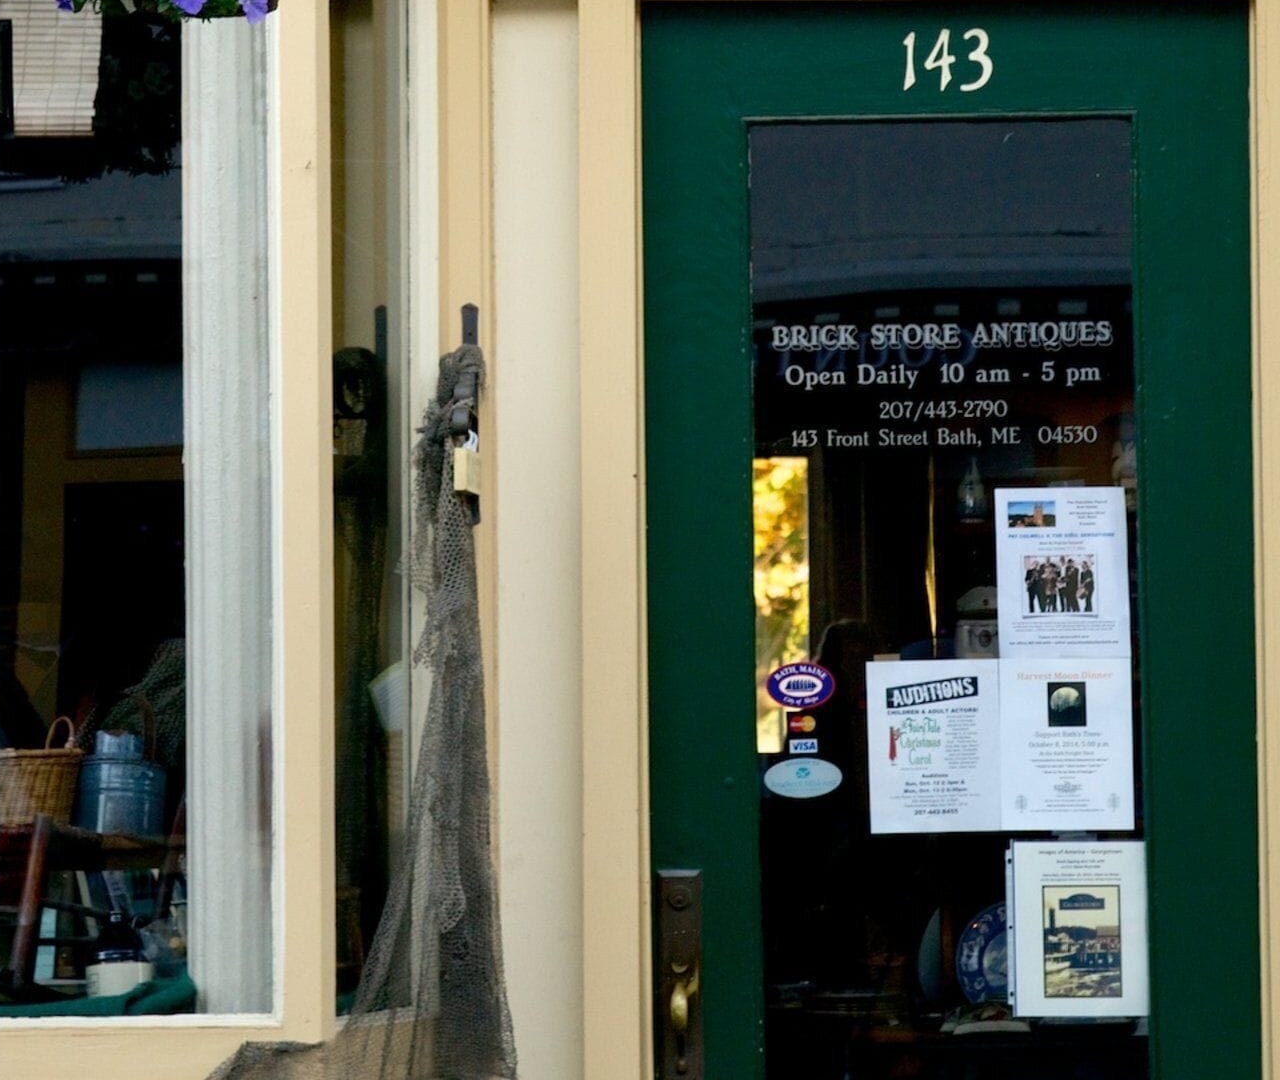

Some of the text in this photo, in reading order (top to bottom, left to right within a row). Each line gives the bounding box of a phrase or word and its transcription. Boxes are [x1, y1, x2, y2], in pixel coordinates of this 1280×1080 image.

[902, 27, 995, 92] 143
[772, 321, 1113, 351] BRICK STORE ANTIQUES
[785, 365, 846, 390] Open
[858, 364, 919, 387] Daily
[940, 363, 964, 383] 10
[975, 368, 1010, 383] am
[1041, 362, 1055, 382] 5
[1066, 367, 1101, 386] pm
[879, 399, 1008, 422] 207/443-2790
[791, 425, 1098, 447] 143 Front Street Bath, ME 04530
[892, 678, 975, 707] AUDITIONS
[792, 741, 816, 751] VISA
